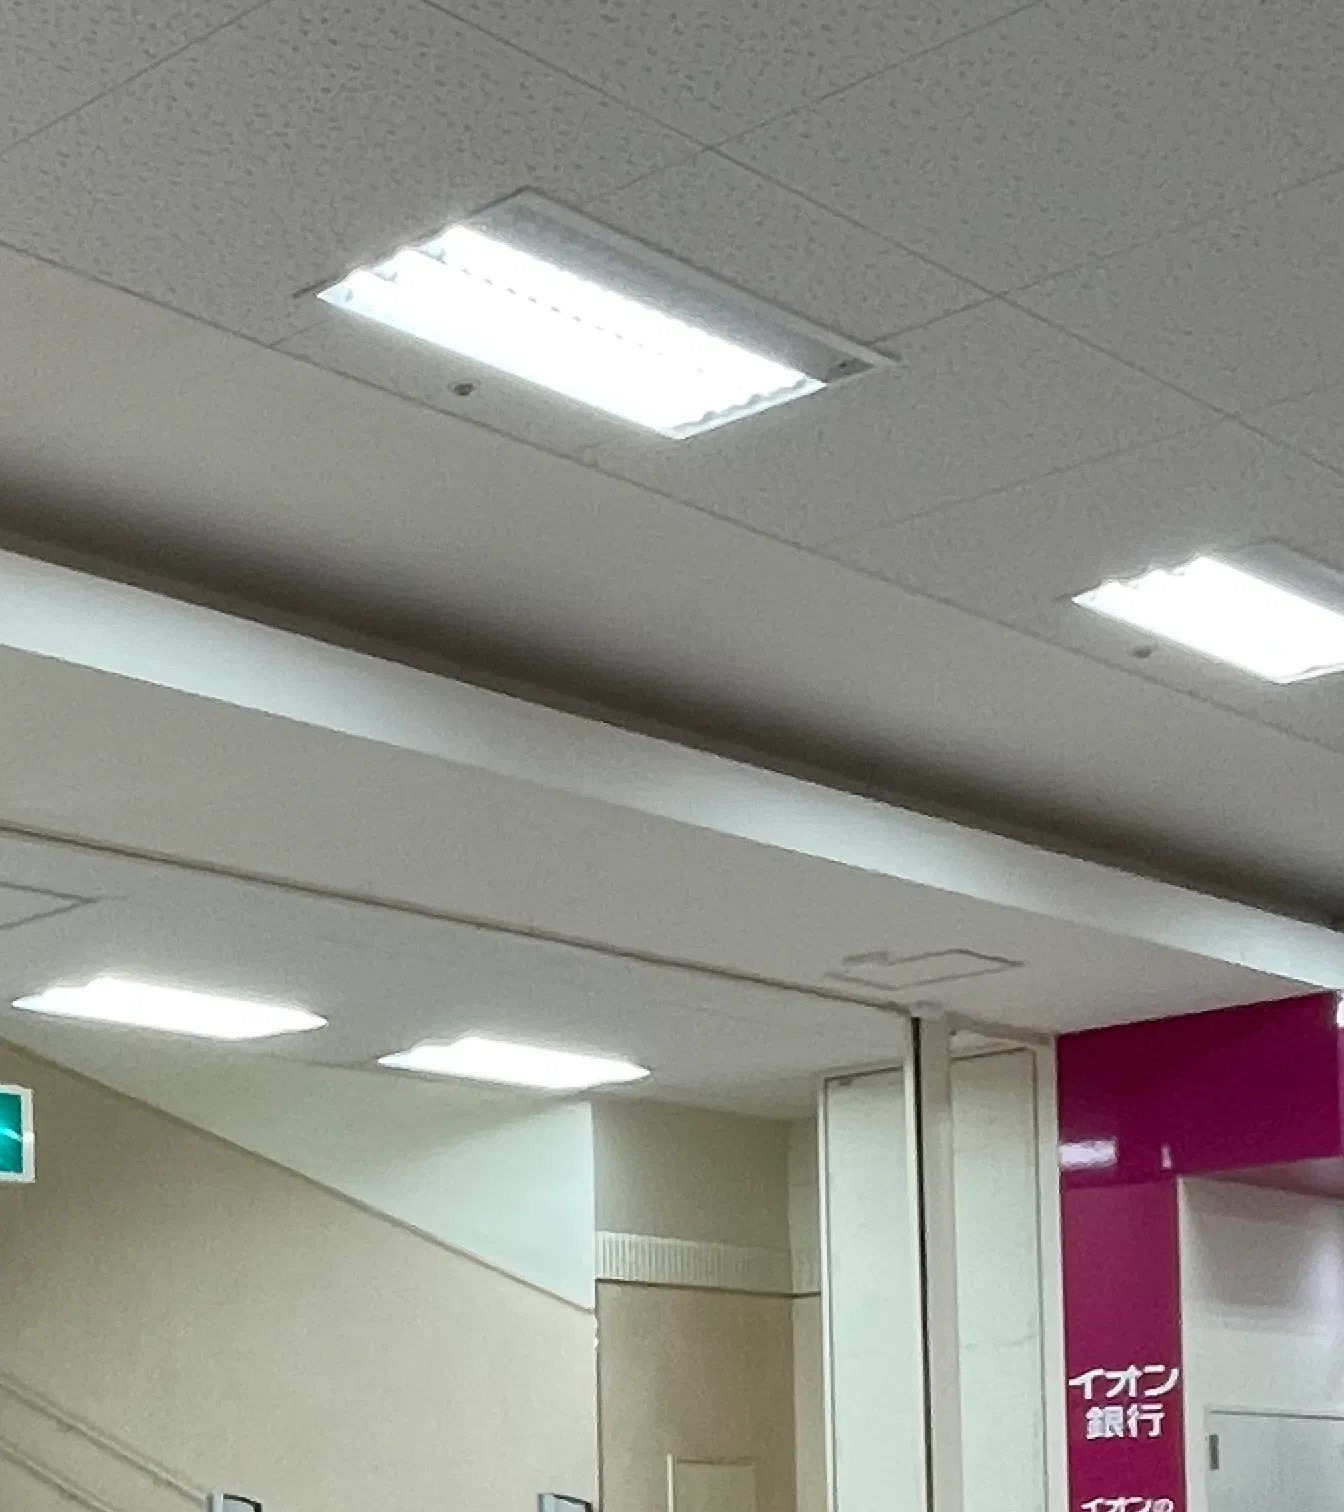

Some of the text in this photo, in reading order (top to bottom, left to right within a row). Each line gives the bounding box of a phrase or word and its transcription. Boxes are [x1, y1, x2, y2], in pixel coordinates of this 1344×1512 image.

[1068, 1364, 1180, 1400] イオン
[1085, 1403, 1166, 1440] 銀行
